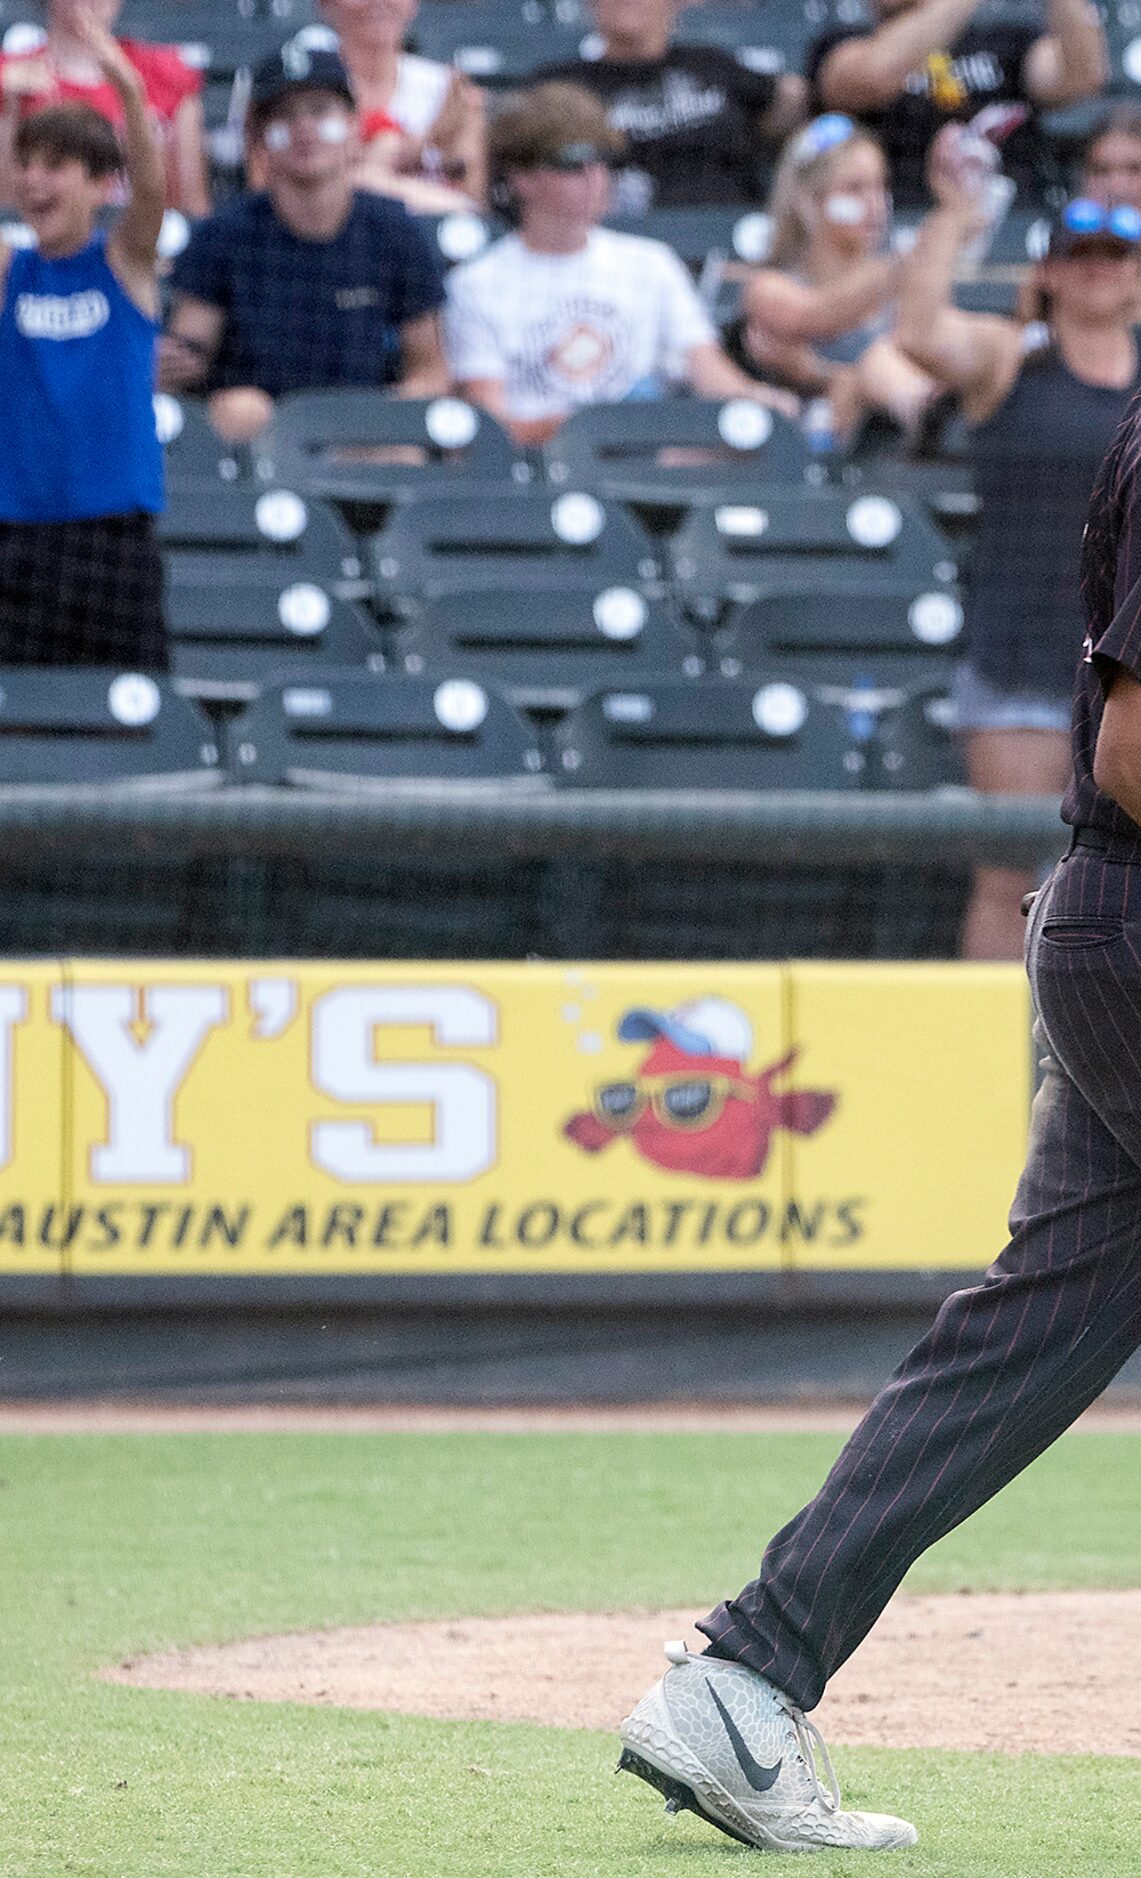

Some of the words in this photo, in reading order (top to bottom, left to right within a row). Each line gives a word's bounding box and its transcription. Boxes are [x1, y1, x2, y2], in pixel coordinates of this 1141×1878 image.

[0, 979, 500, 1187] Y'S
[0, 1199, 253, 1250] AUSTIN
[266, 1199, 453, 1249] AREA
[478, 1196, 869, 1249] LOCATIONS
